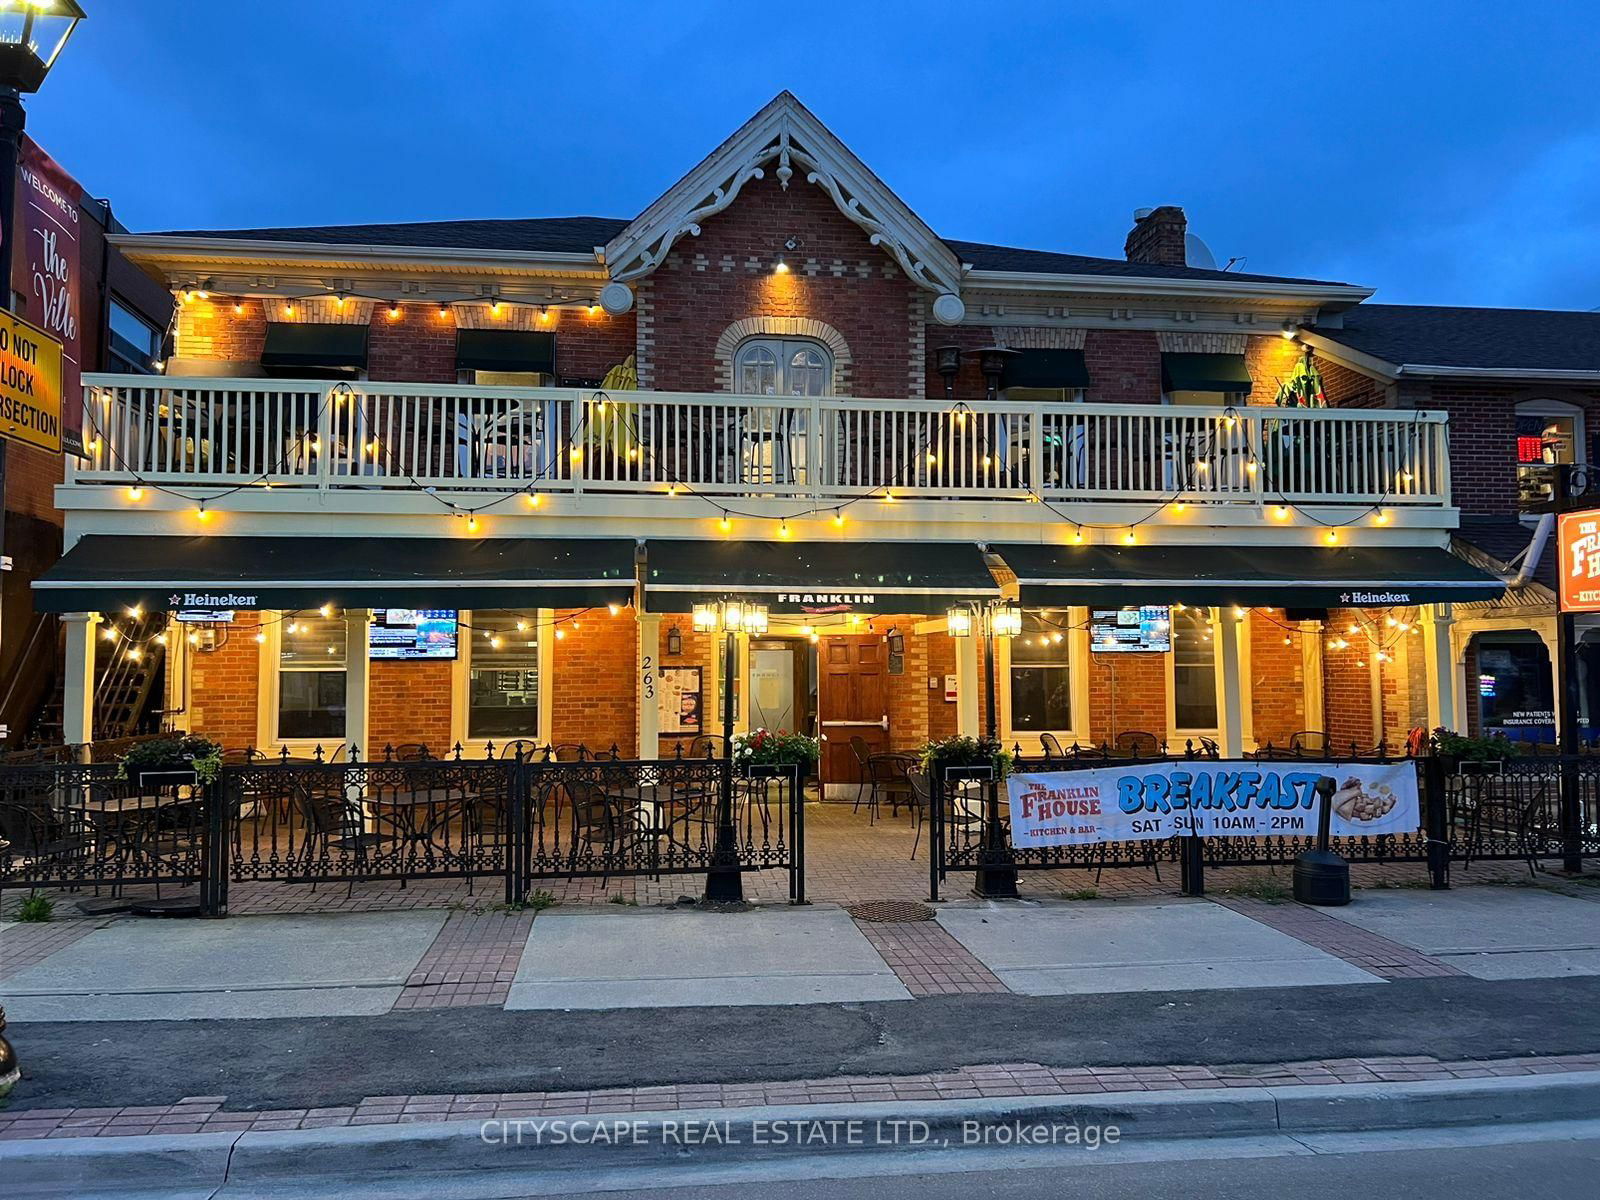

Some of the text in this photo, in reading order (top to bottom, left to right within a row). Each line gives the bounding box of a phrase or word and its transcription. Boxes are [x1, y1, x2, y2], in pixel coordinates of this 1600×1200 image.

[20, 166, 78, 223] WELCOME TO
[33, 229, 69, 282] the
[13, 333, 38, 365] NOT
[1579, 522, 1597, 534] THE
[183, 593, 257, 606] Heineken
[778, 594, 875, 604] FRANKLIN
[1352, 592, 1410, 603] Heineken
[641, 656, 654, 699] 263
[1028, 783, 1047, 791] THE
[1117, 771, 1321, 815] BREAKFAST
[1020, 786, 1099, 819] FRANKLIN
[1037, 799, 1102, 822] HOUSE
[1030, 825, 1096, 837] KITCHEN & BAR
[1132, 819, 1162, 833] SAT
[1212, 816, 1256, 829] 10AM
[1271, 816, 1304, 829] 2PM
